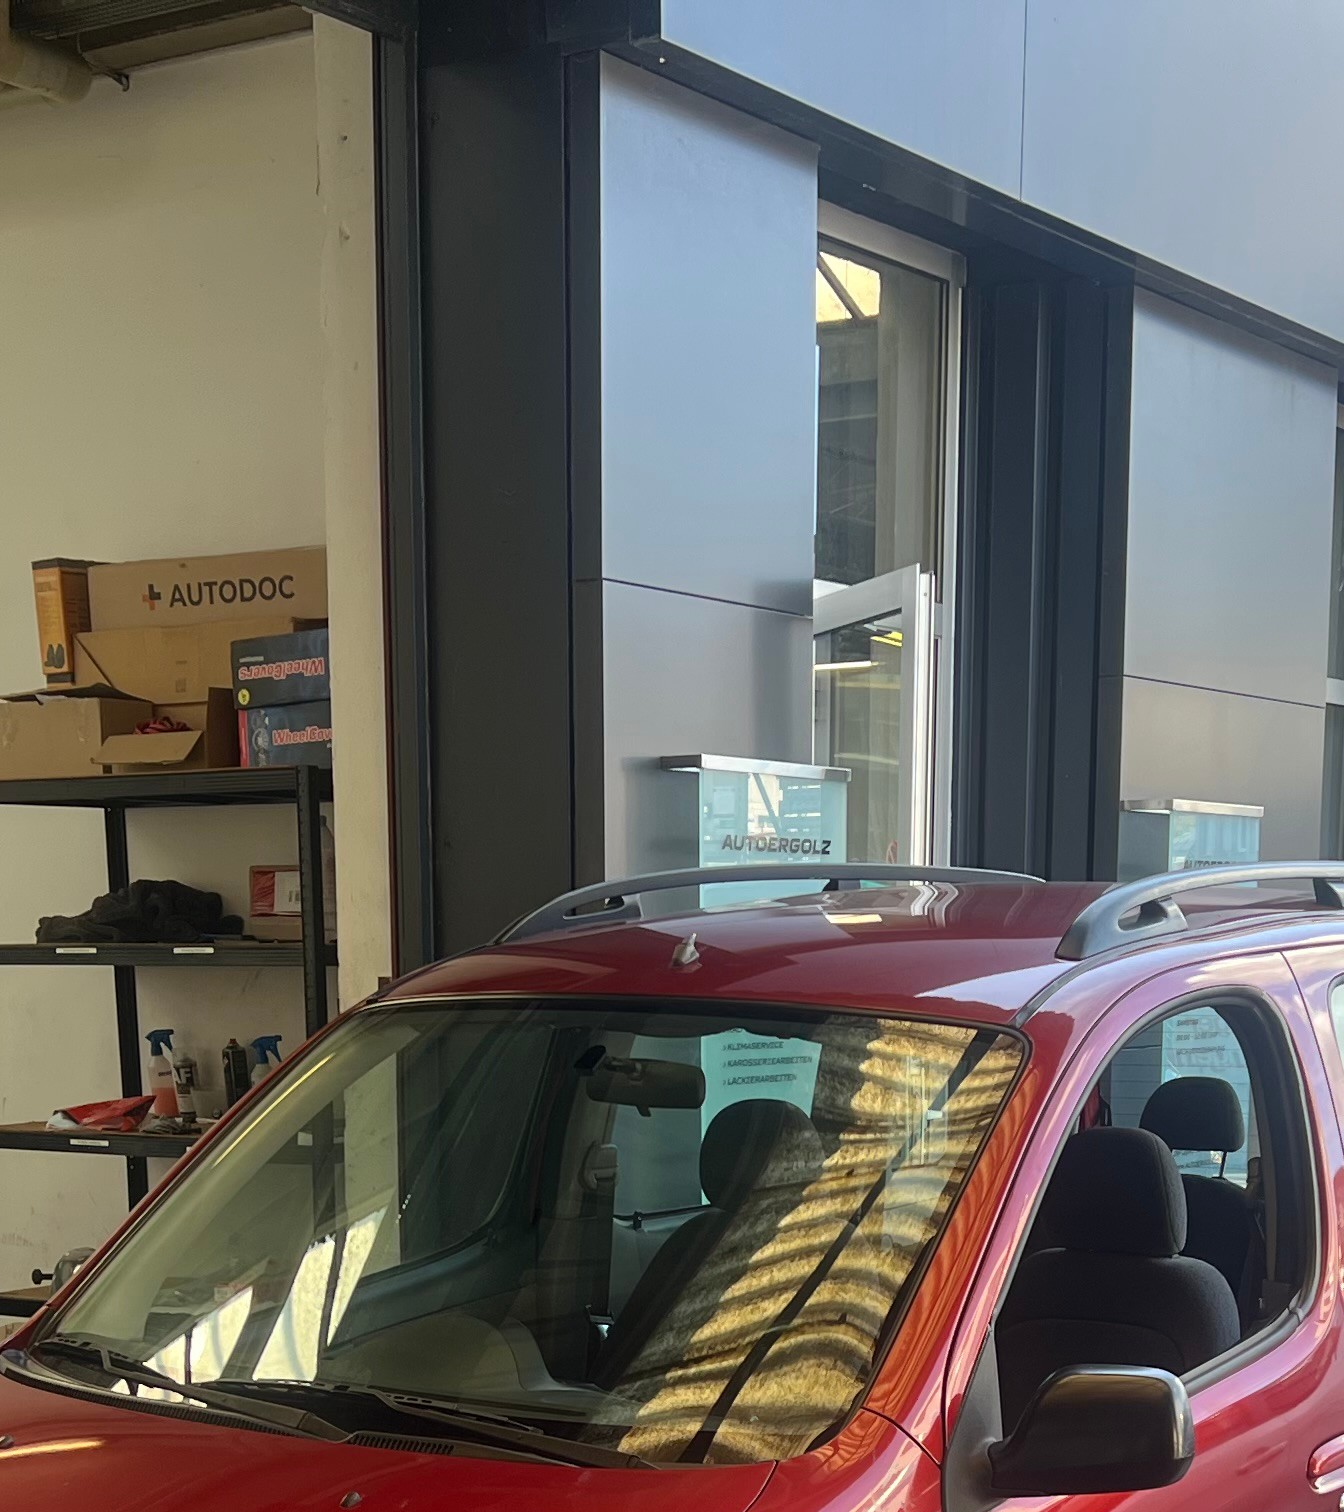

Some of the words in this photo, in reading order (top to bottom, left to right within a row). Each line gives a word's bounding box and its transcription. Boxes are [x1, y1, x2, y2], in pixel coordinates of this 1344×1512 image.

[169, 574, 295, 608] AUTODOC
[272, 726, 331, 745] WheelCov
[721, 834, 832, 855] AUTOERGOLZ
